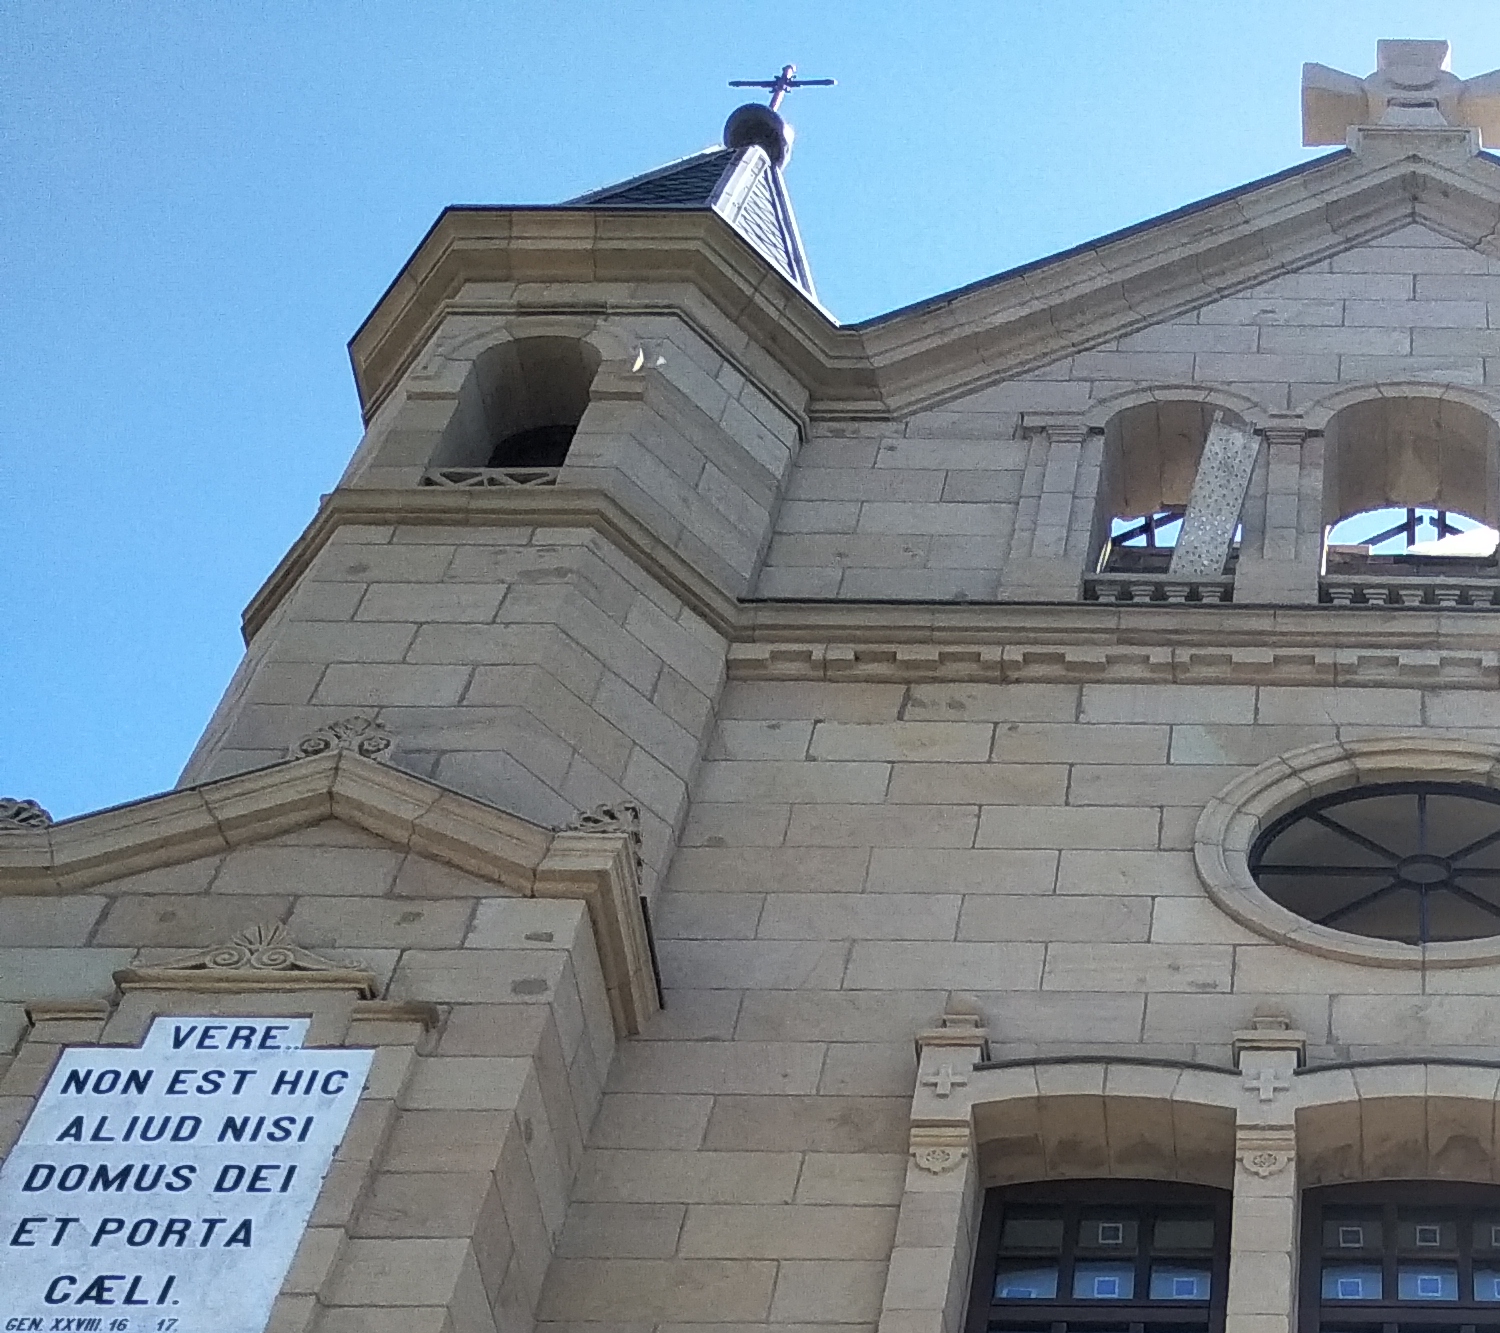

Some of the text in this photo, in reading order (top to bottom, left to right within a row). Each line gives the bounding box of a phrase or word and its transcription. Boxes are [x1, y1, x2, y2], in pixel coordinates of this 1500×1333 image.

[60, 1069, 349, 1096] NON EST HIC
[56, 1116, 314, 1142] ALIUD NISI
[22, 1164, 297, 1193] DOMUS DEI
[9, 1217, 252, 1248] ET PORTA
[44, 1275, 180, 1305] CÆLI.
[109, 1318, 130, 1332] 16
